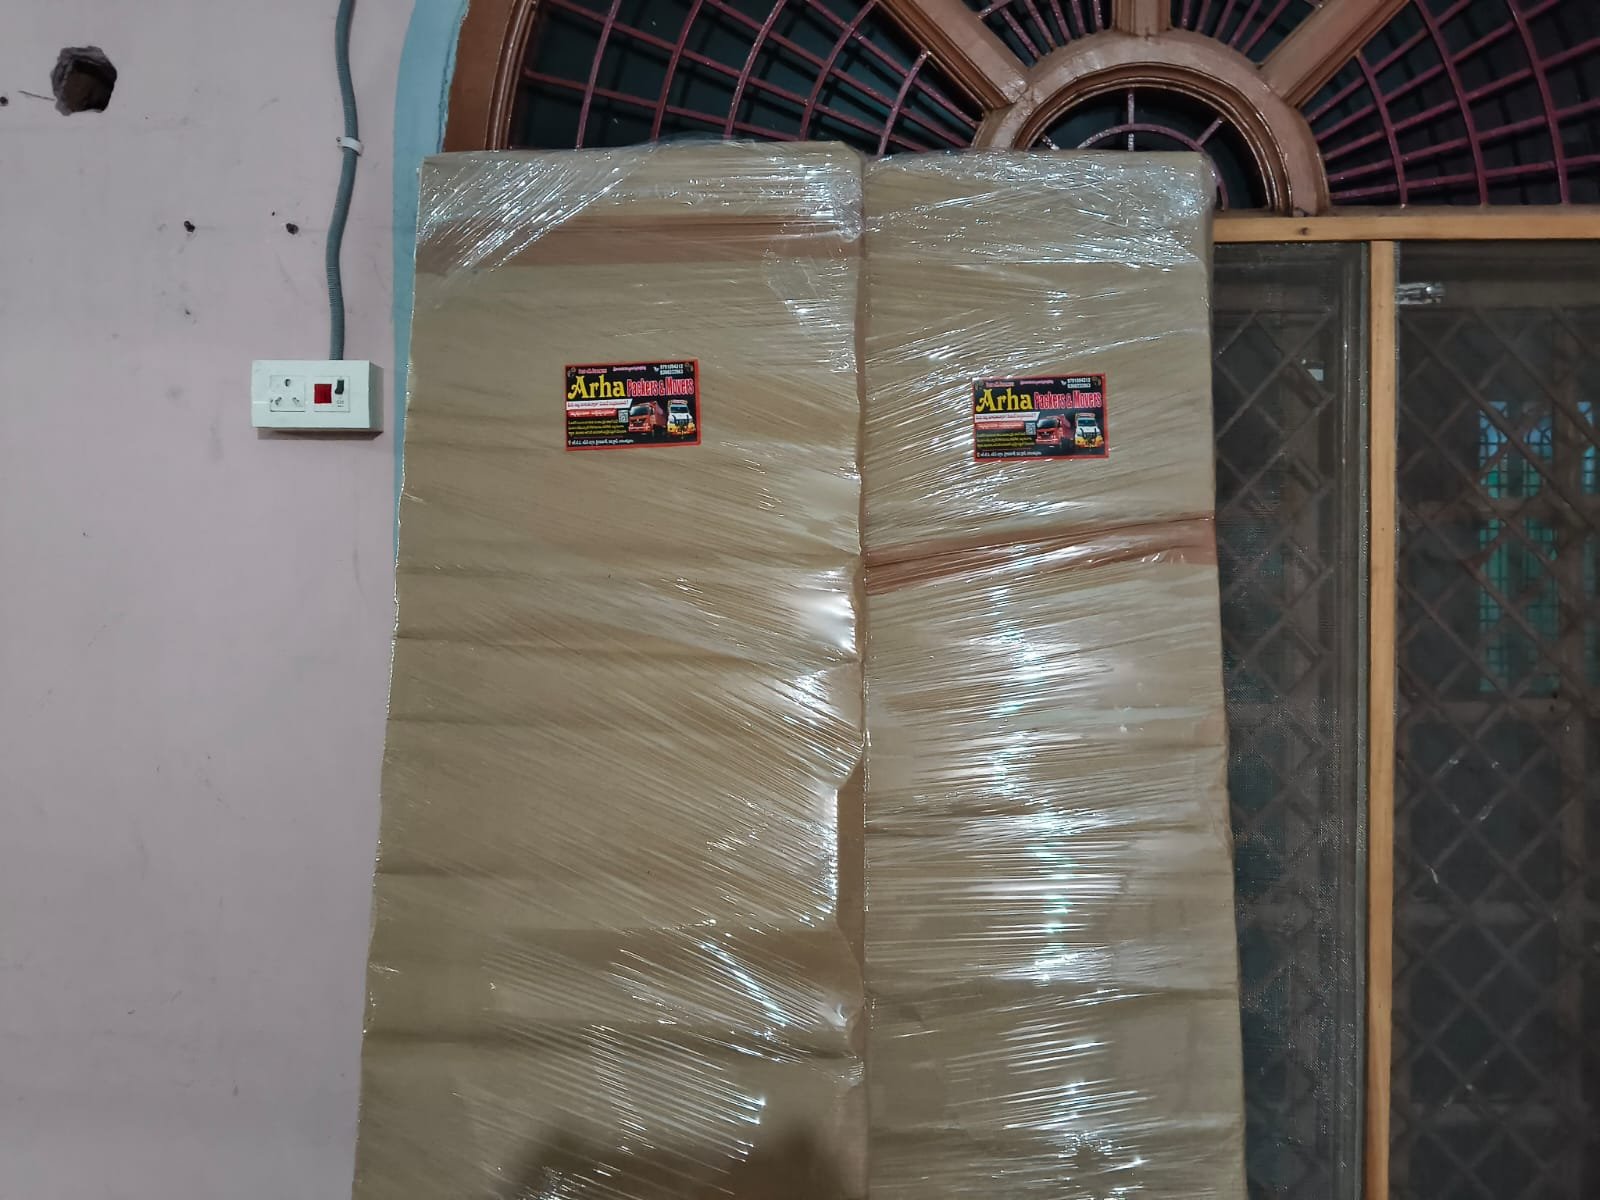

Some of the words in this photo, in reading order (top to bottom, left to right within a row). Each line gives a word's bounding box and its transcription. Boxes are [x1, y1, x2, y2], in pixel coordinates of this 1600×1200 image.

[568, 374, 626, 400] Arha
[626, 378, 658, 397] Packers
[659, 380, 665, 396] &
[665, 376, 694, 396] Movers
[976, 388, 1034, 412] Arha
[1034, 391, 1065, 410] Packers
[1066, 394, 1072, 409] &
[1073, 390, 1102, 408] Movers
